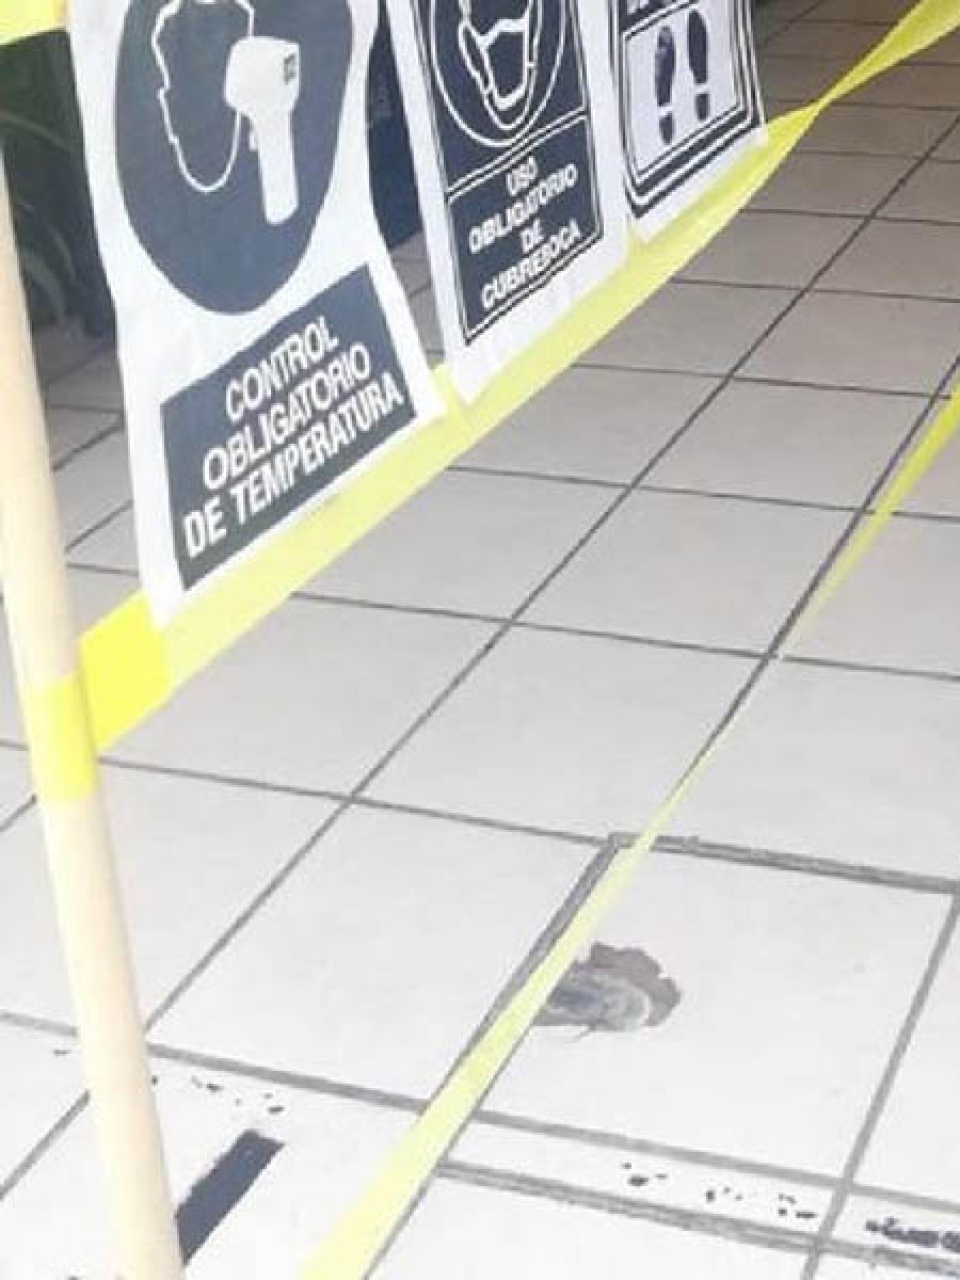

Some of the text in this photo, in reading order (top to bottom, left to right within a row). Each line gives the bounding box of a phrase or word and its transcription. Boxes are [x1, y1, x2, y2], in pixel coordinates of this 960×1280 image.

[469, 164, 578, 254] OBLIGATORIO
[506, 155, 538, 197] USO
[482, 218, 582, 310] CUBREBOCA
[520, 219, 545, 254] DE
[225, 316, 339, 423] CONTROL
[203, 343, 371, 490] OBLIGATORIO
[184, 371, 405, 559] DE TEMPERATURA
